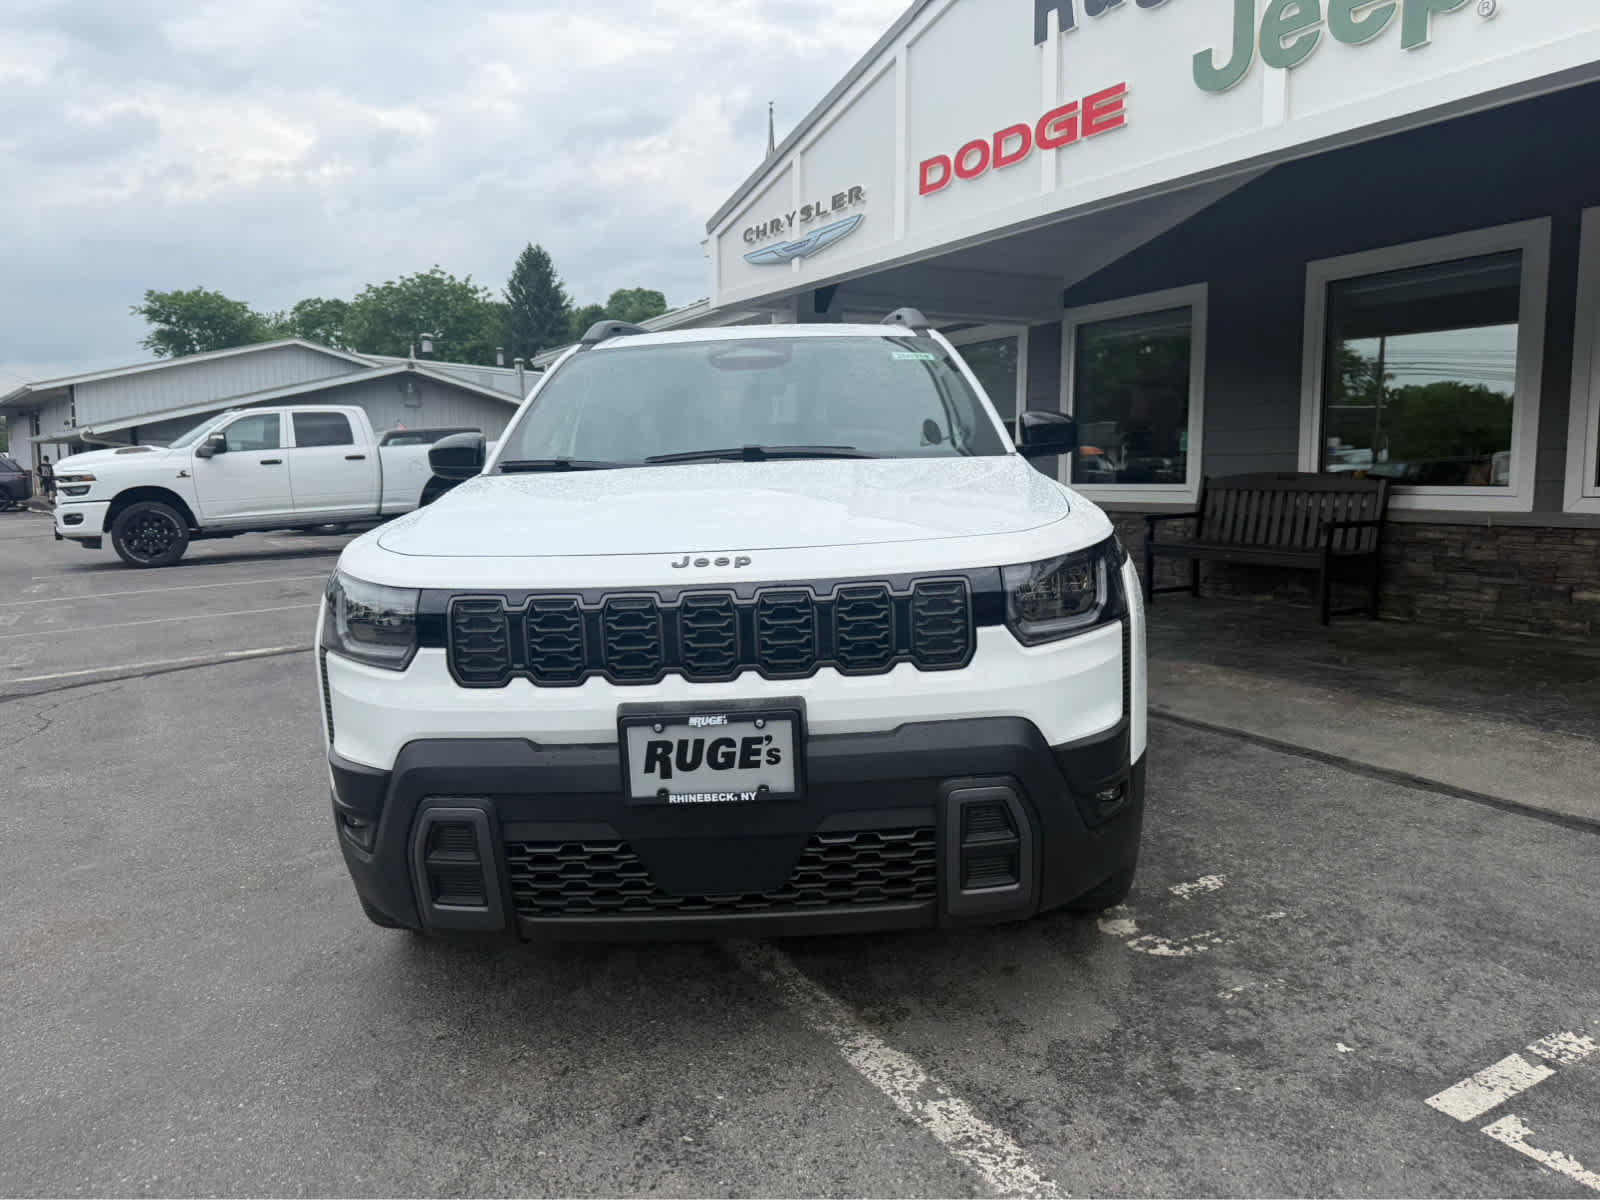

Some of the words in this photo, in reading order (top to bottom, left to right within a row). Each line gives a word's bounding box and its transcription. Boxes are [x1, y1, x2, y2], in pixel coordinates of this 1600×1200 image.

[919, 82, 1127, 196] DODGE
[743, 186, 864, 243] CHRYSLER
[671, 556, 752, 569] Jeep
[644, 735, 782, 780] RUGE's
[741, 792, 757, 801] NY
